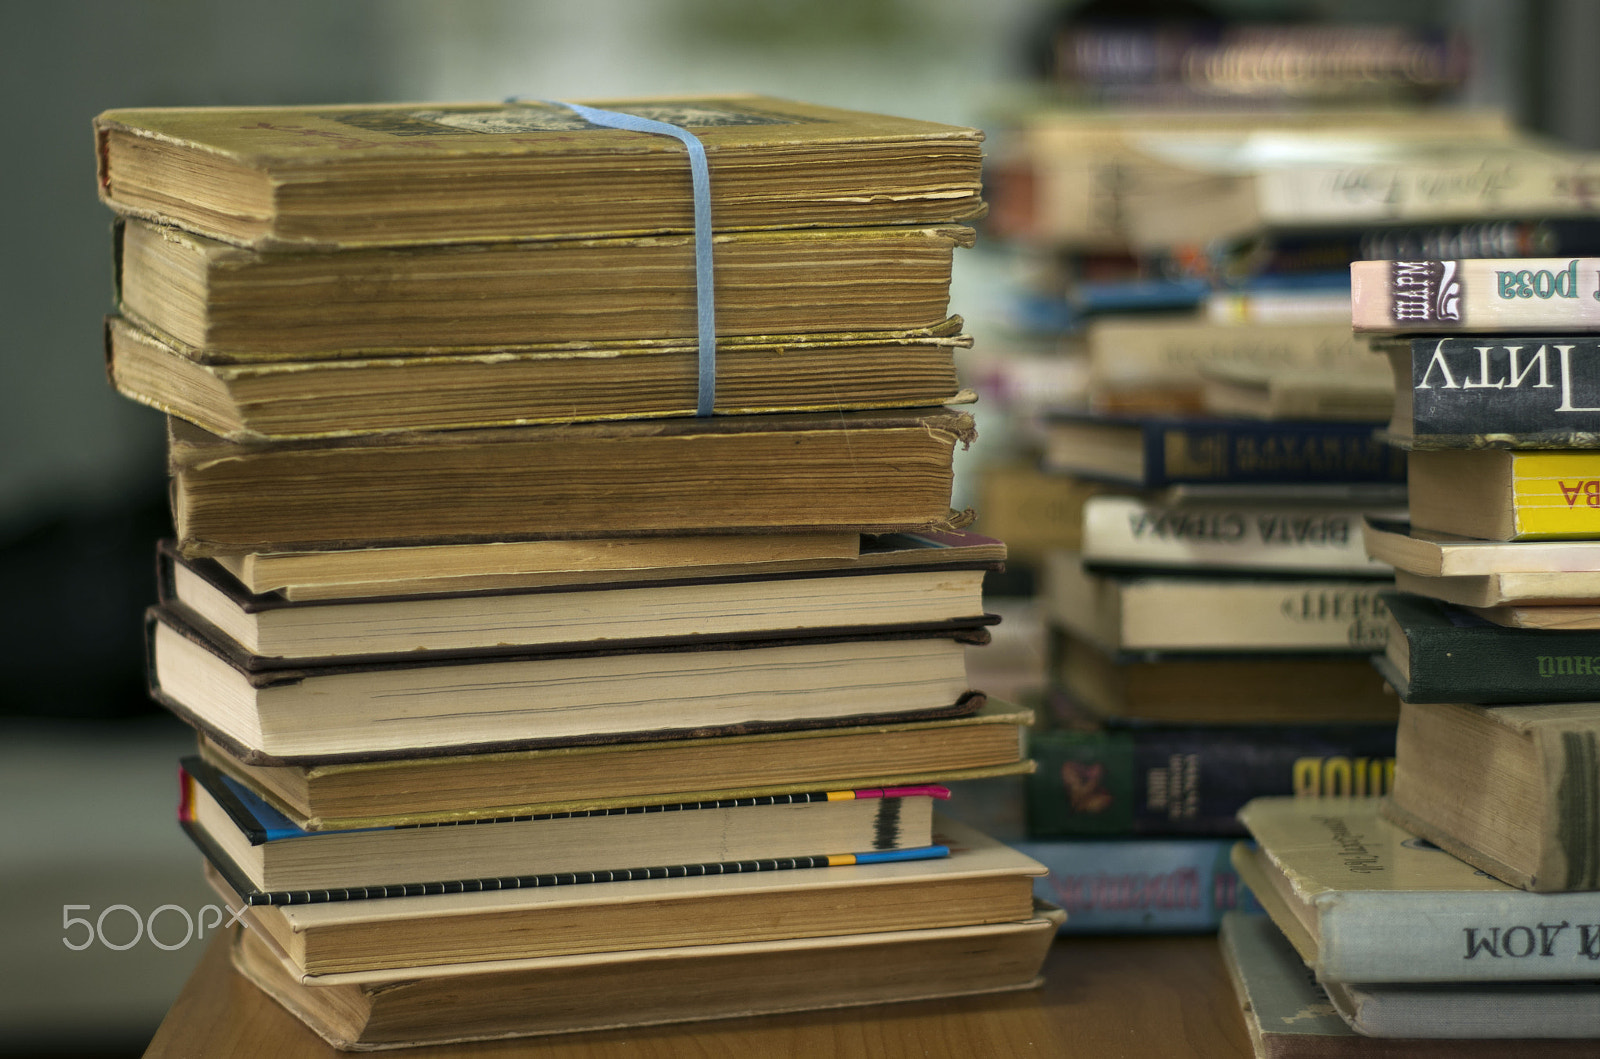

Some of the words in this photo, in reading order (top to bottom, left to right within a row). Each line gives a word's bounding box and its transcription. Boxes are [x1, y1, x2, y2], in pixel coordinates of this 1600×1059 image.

[1392, 261, 1433, 320] ШАРМ
[1495, 260, 1580, 300] роза
[1257, 514, 1349, 546] ВРАТА
[1463, 921, 1569, 960] ДОМ
